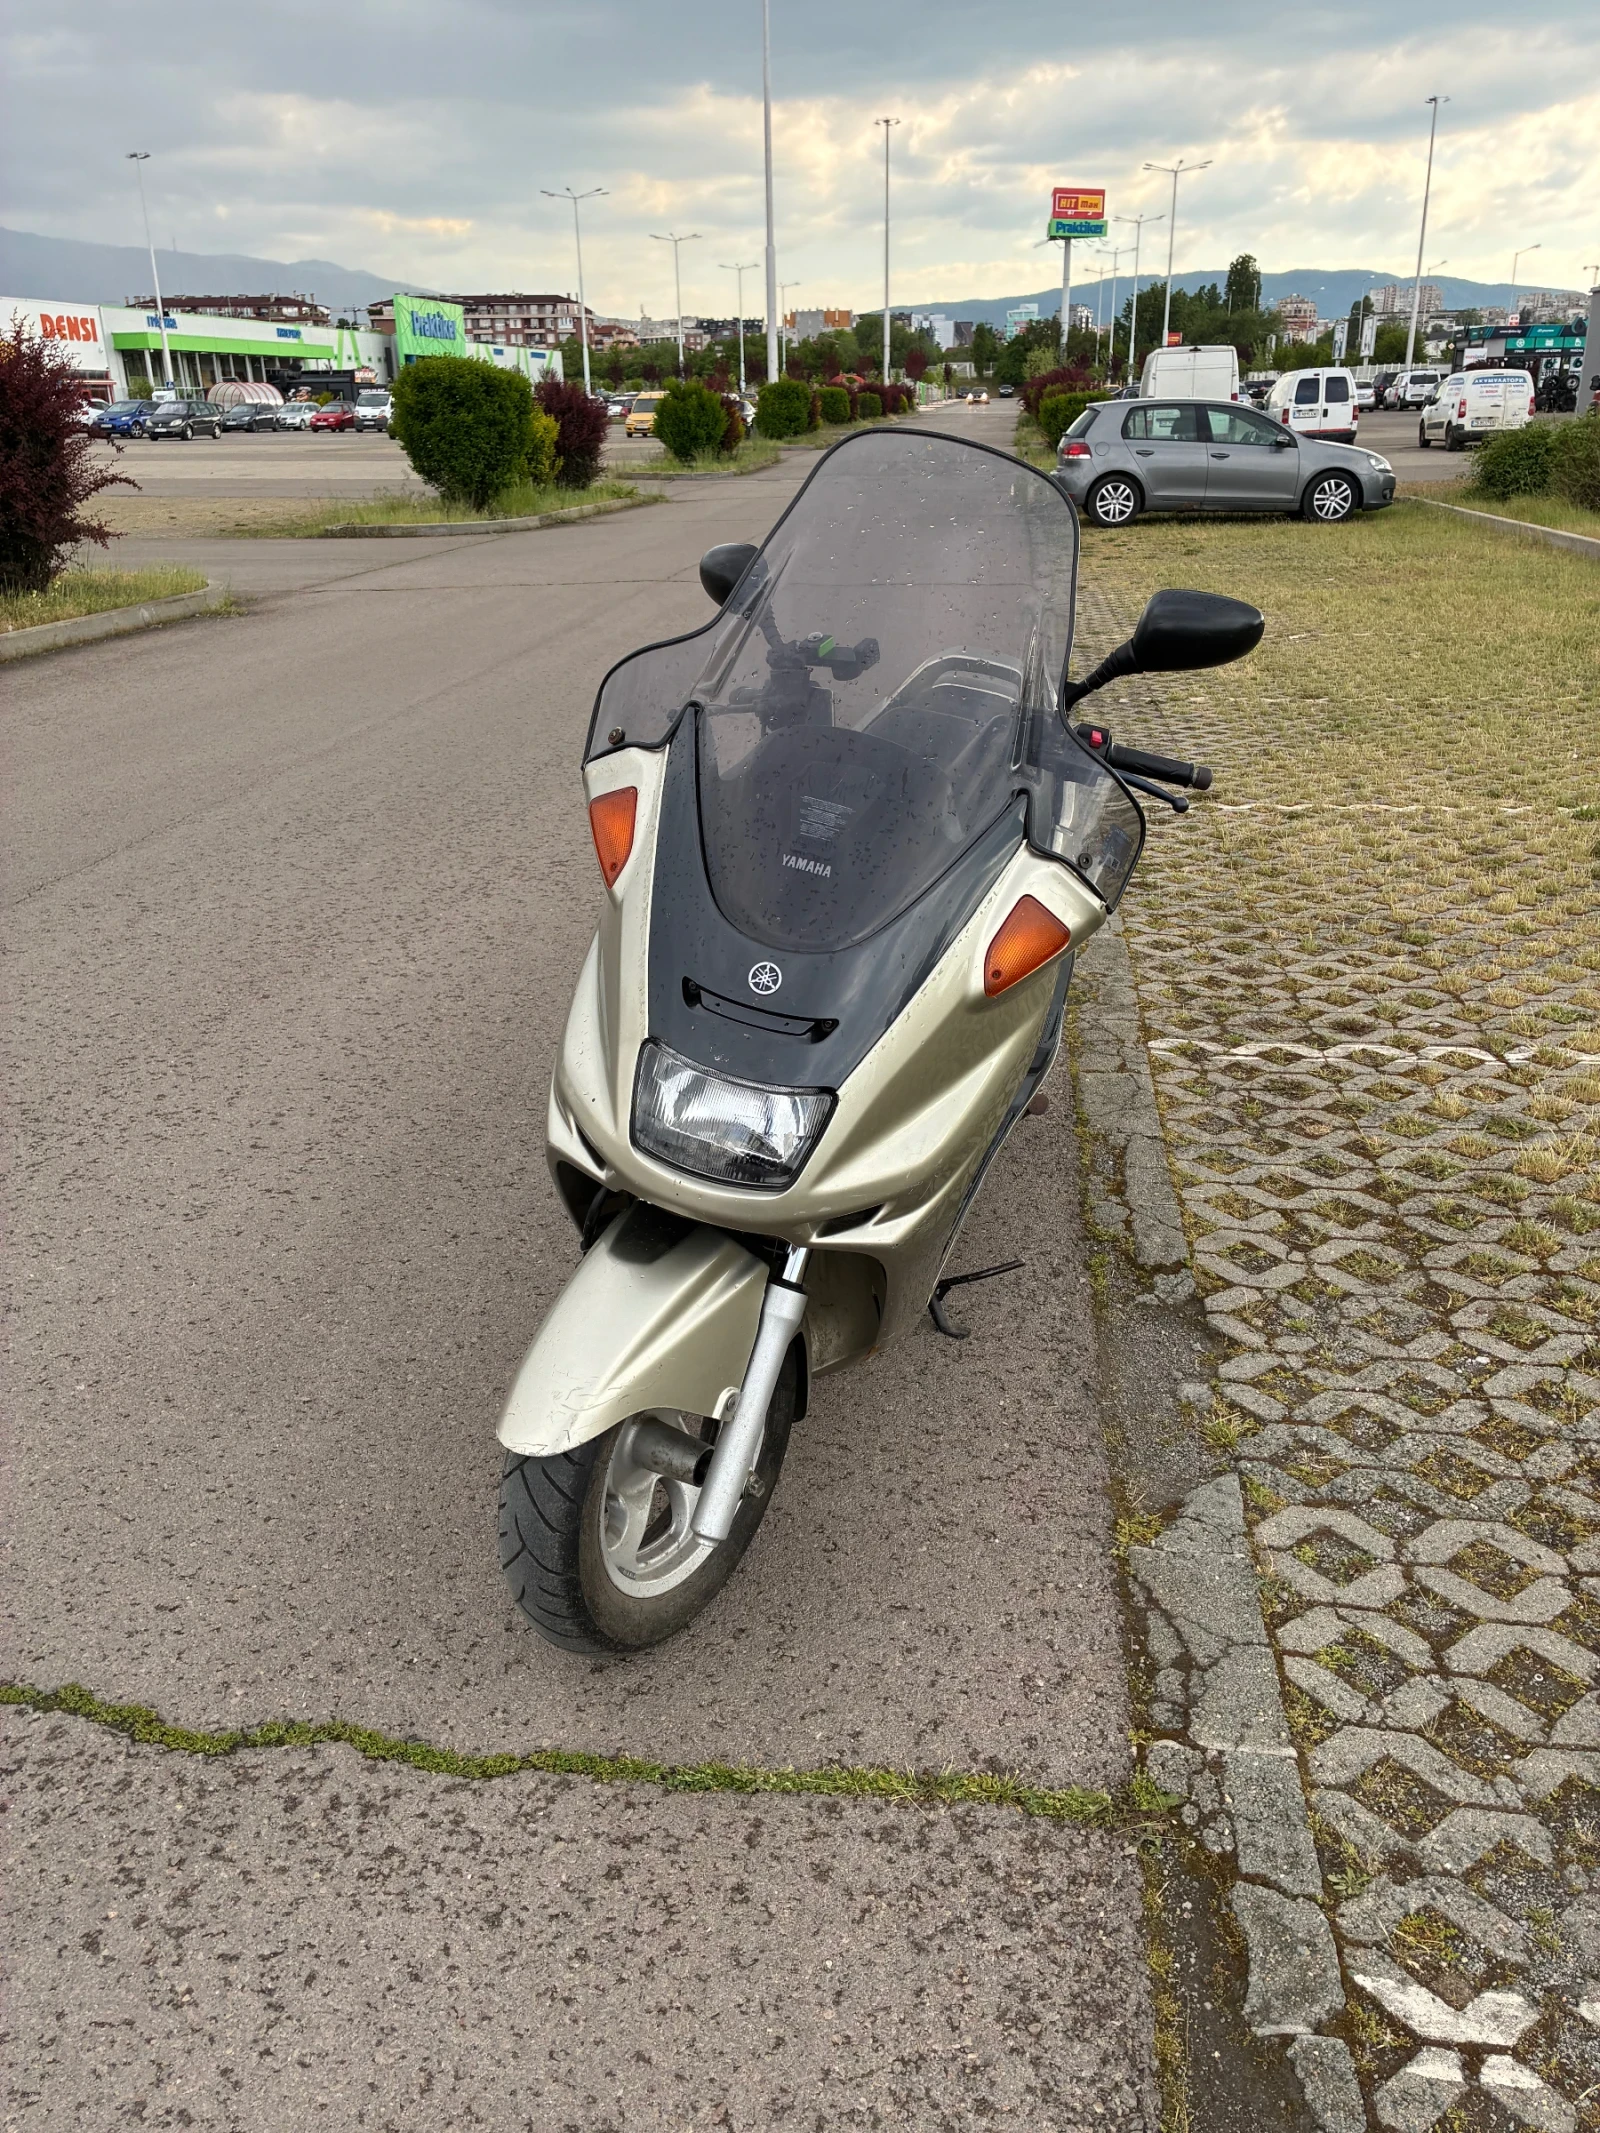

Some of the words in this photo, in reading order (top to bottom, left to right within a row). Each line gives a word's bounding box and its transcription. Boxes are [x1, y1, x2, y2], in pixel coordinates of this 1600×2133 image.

[1060, 198, 1077, 208] HIT
[1056, 221, 1104, 234] Praktiker
[40, 313, 98, 342] DENSI
[782, 853, 832, 878] YAMAHA
